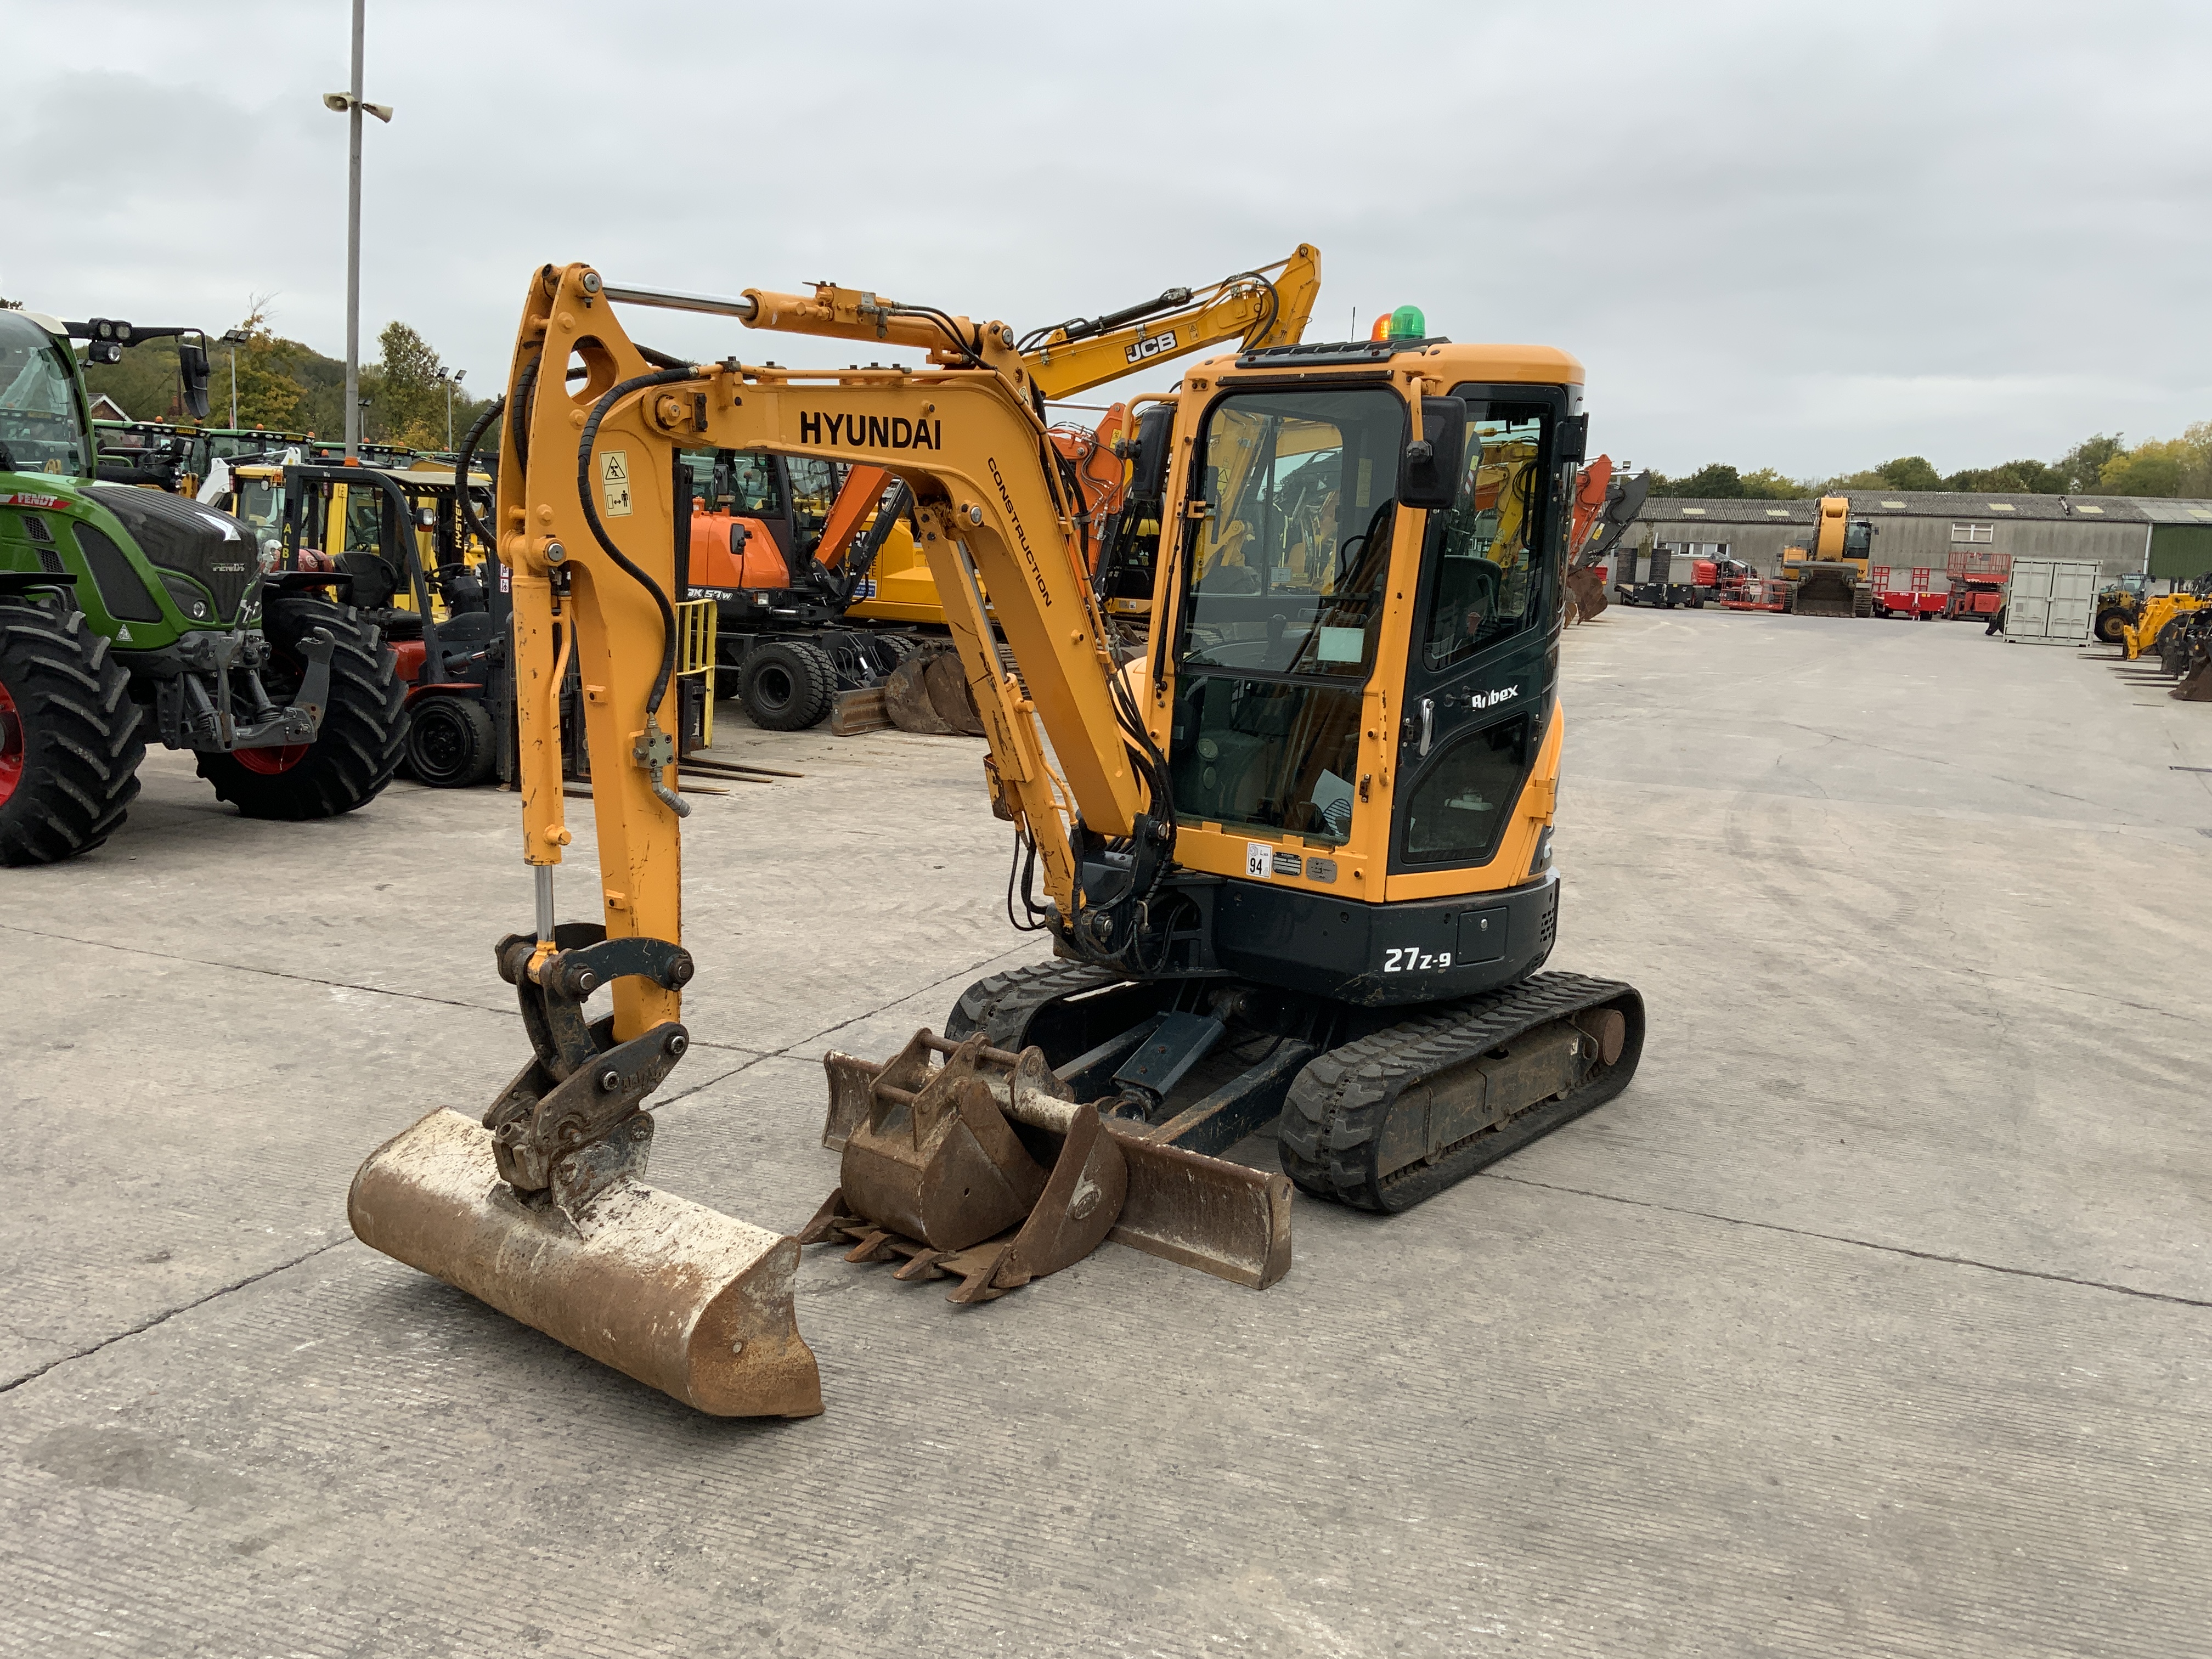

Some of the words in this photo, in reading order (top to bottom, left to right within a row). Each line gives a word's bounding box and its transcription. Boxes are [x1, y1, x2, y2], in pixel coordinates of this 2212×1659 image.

[1127, 332, 1176, 362] JCB
[800, 411, 941, 450] HYUNDAI
[18, 492, 58, 506] FENDT
[988, 457, 1052, 608] CONSTRUCTION
[1250, 857, 1262, 874] 94
